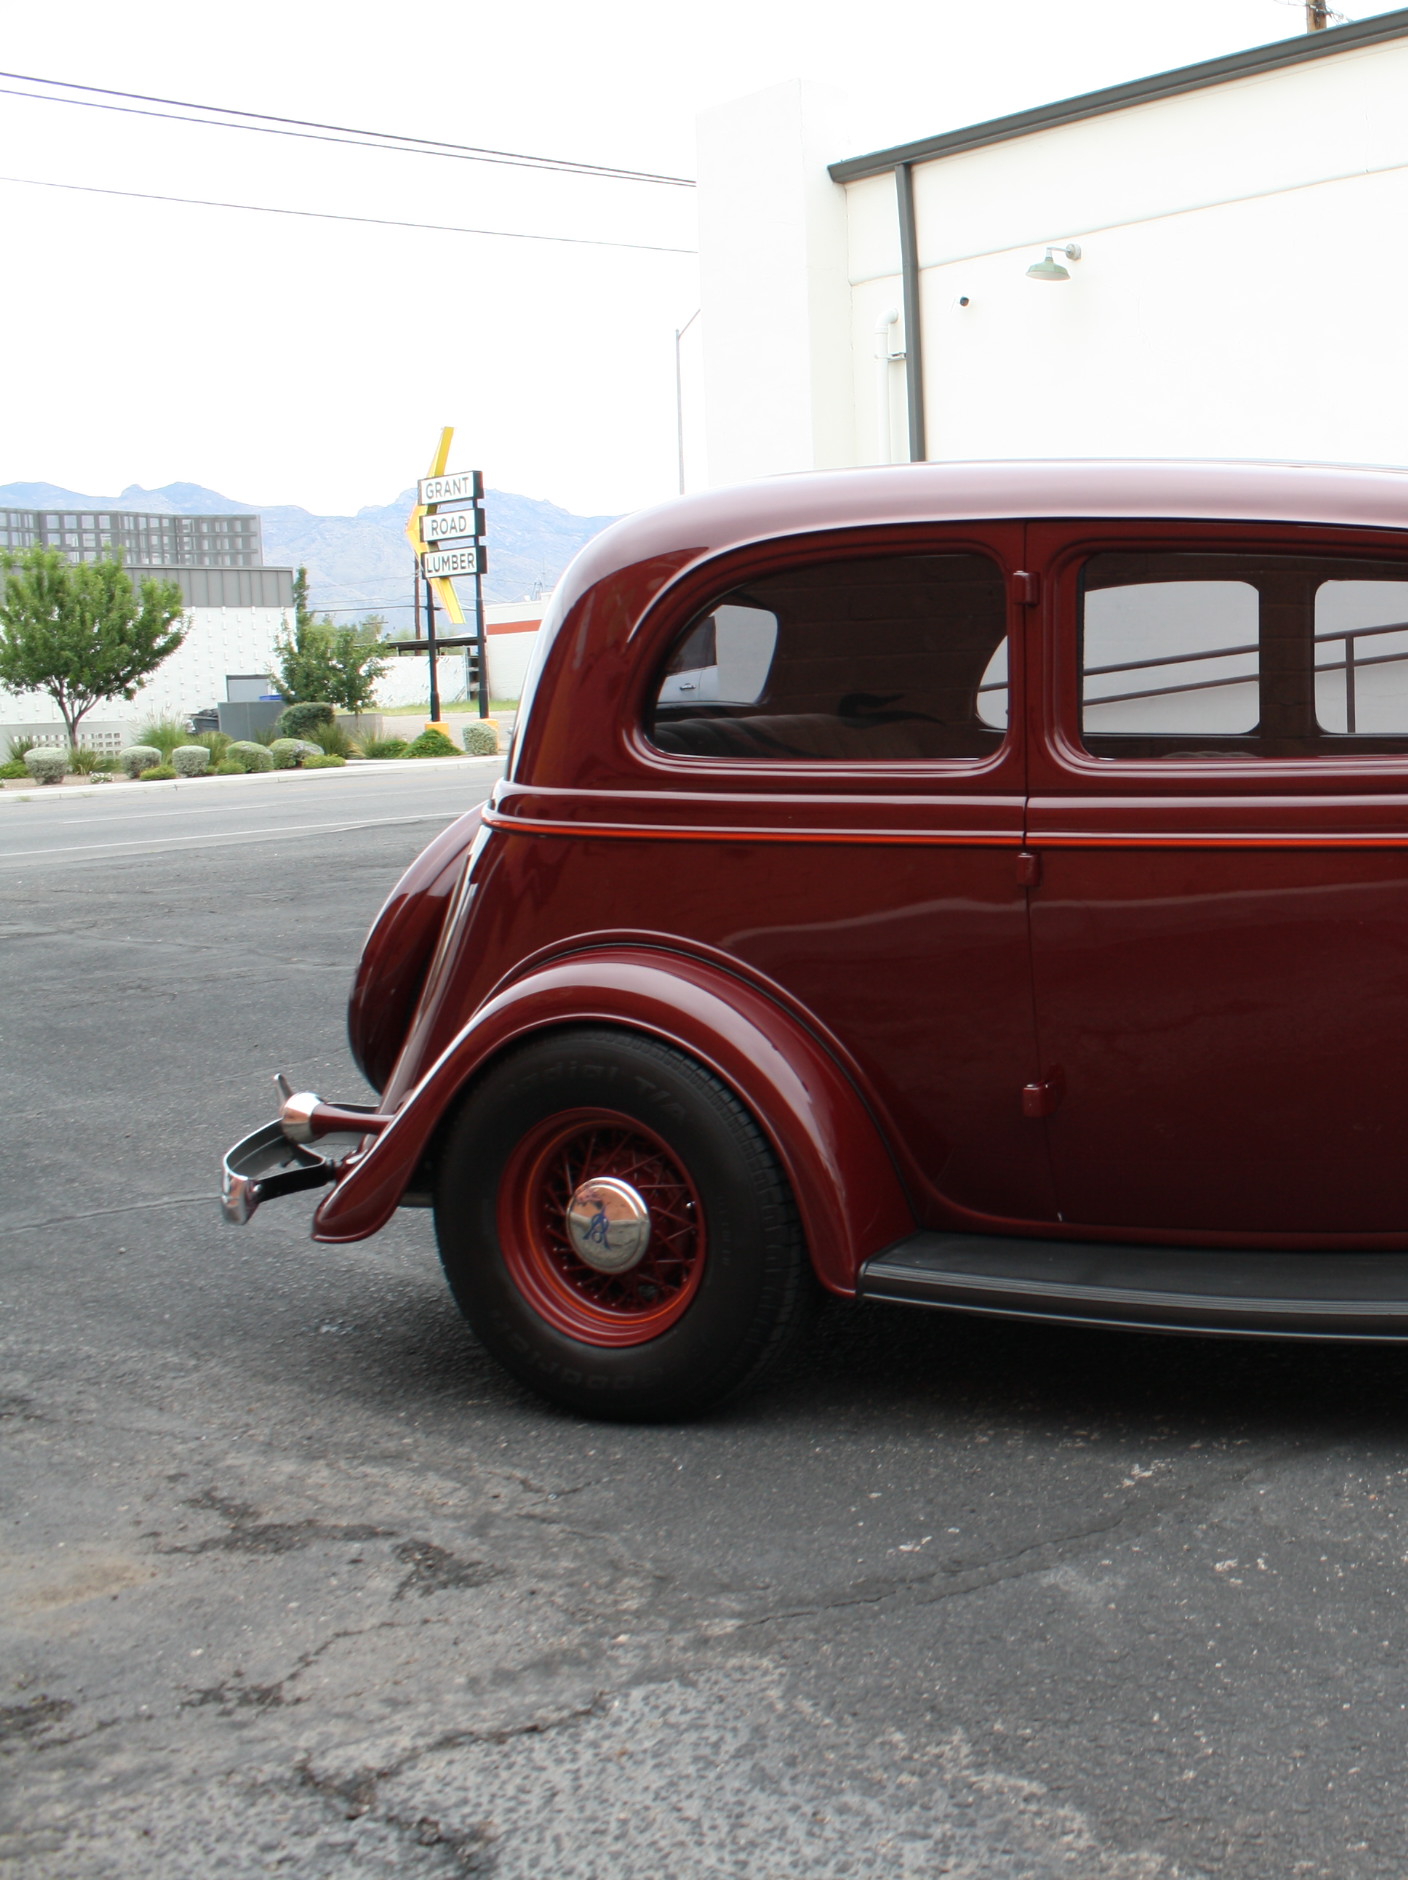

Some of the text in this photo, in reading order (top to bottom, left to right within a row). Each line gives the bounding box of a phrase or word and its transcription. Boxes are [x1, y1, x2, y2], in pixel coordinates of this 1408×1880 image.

[425, 477, 469, 500] GRANT
[431, 515, 467, 536] ROAD
[426, 552, 475, 573] LUMBER
